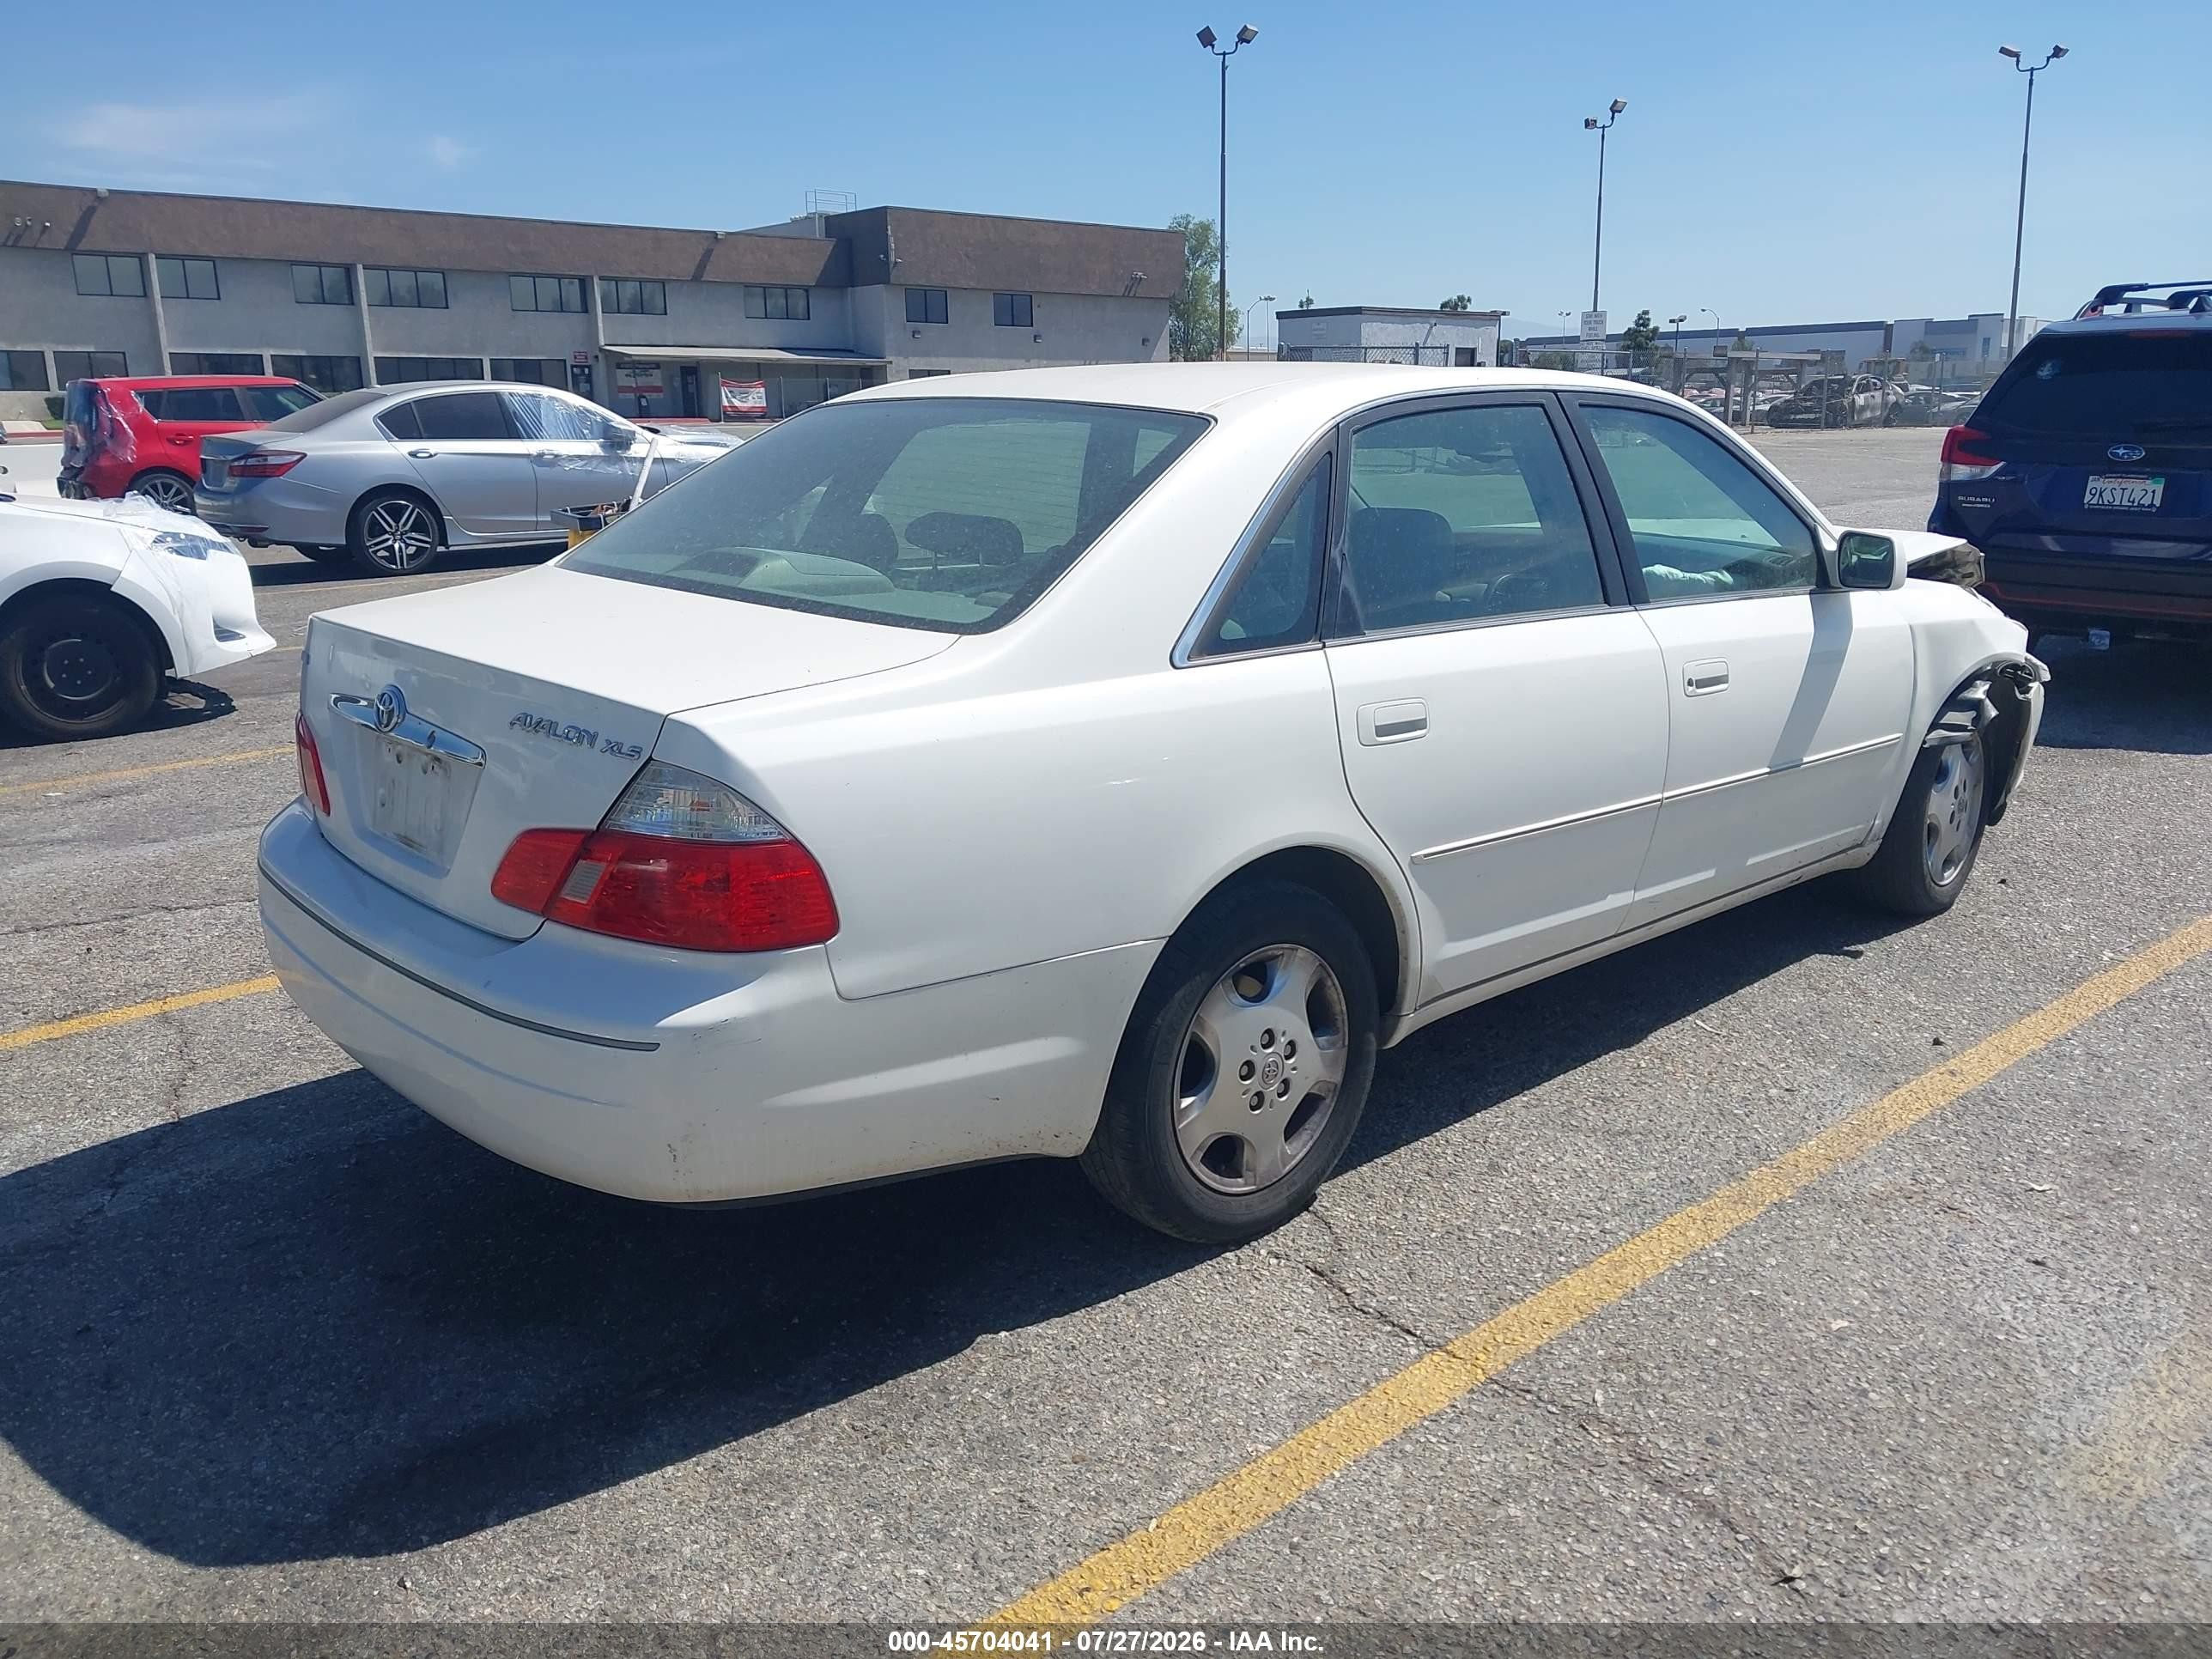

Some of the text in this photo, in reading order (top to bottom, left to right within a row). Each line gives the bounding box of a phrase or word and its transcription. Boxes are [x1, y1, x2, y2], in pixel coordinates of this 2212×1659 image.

[2087, 486, 2157, 507] 9KST421
[508, 712, 599, 750] AVALON
[600, 738, 643, 761] XLS
